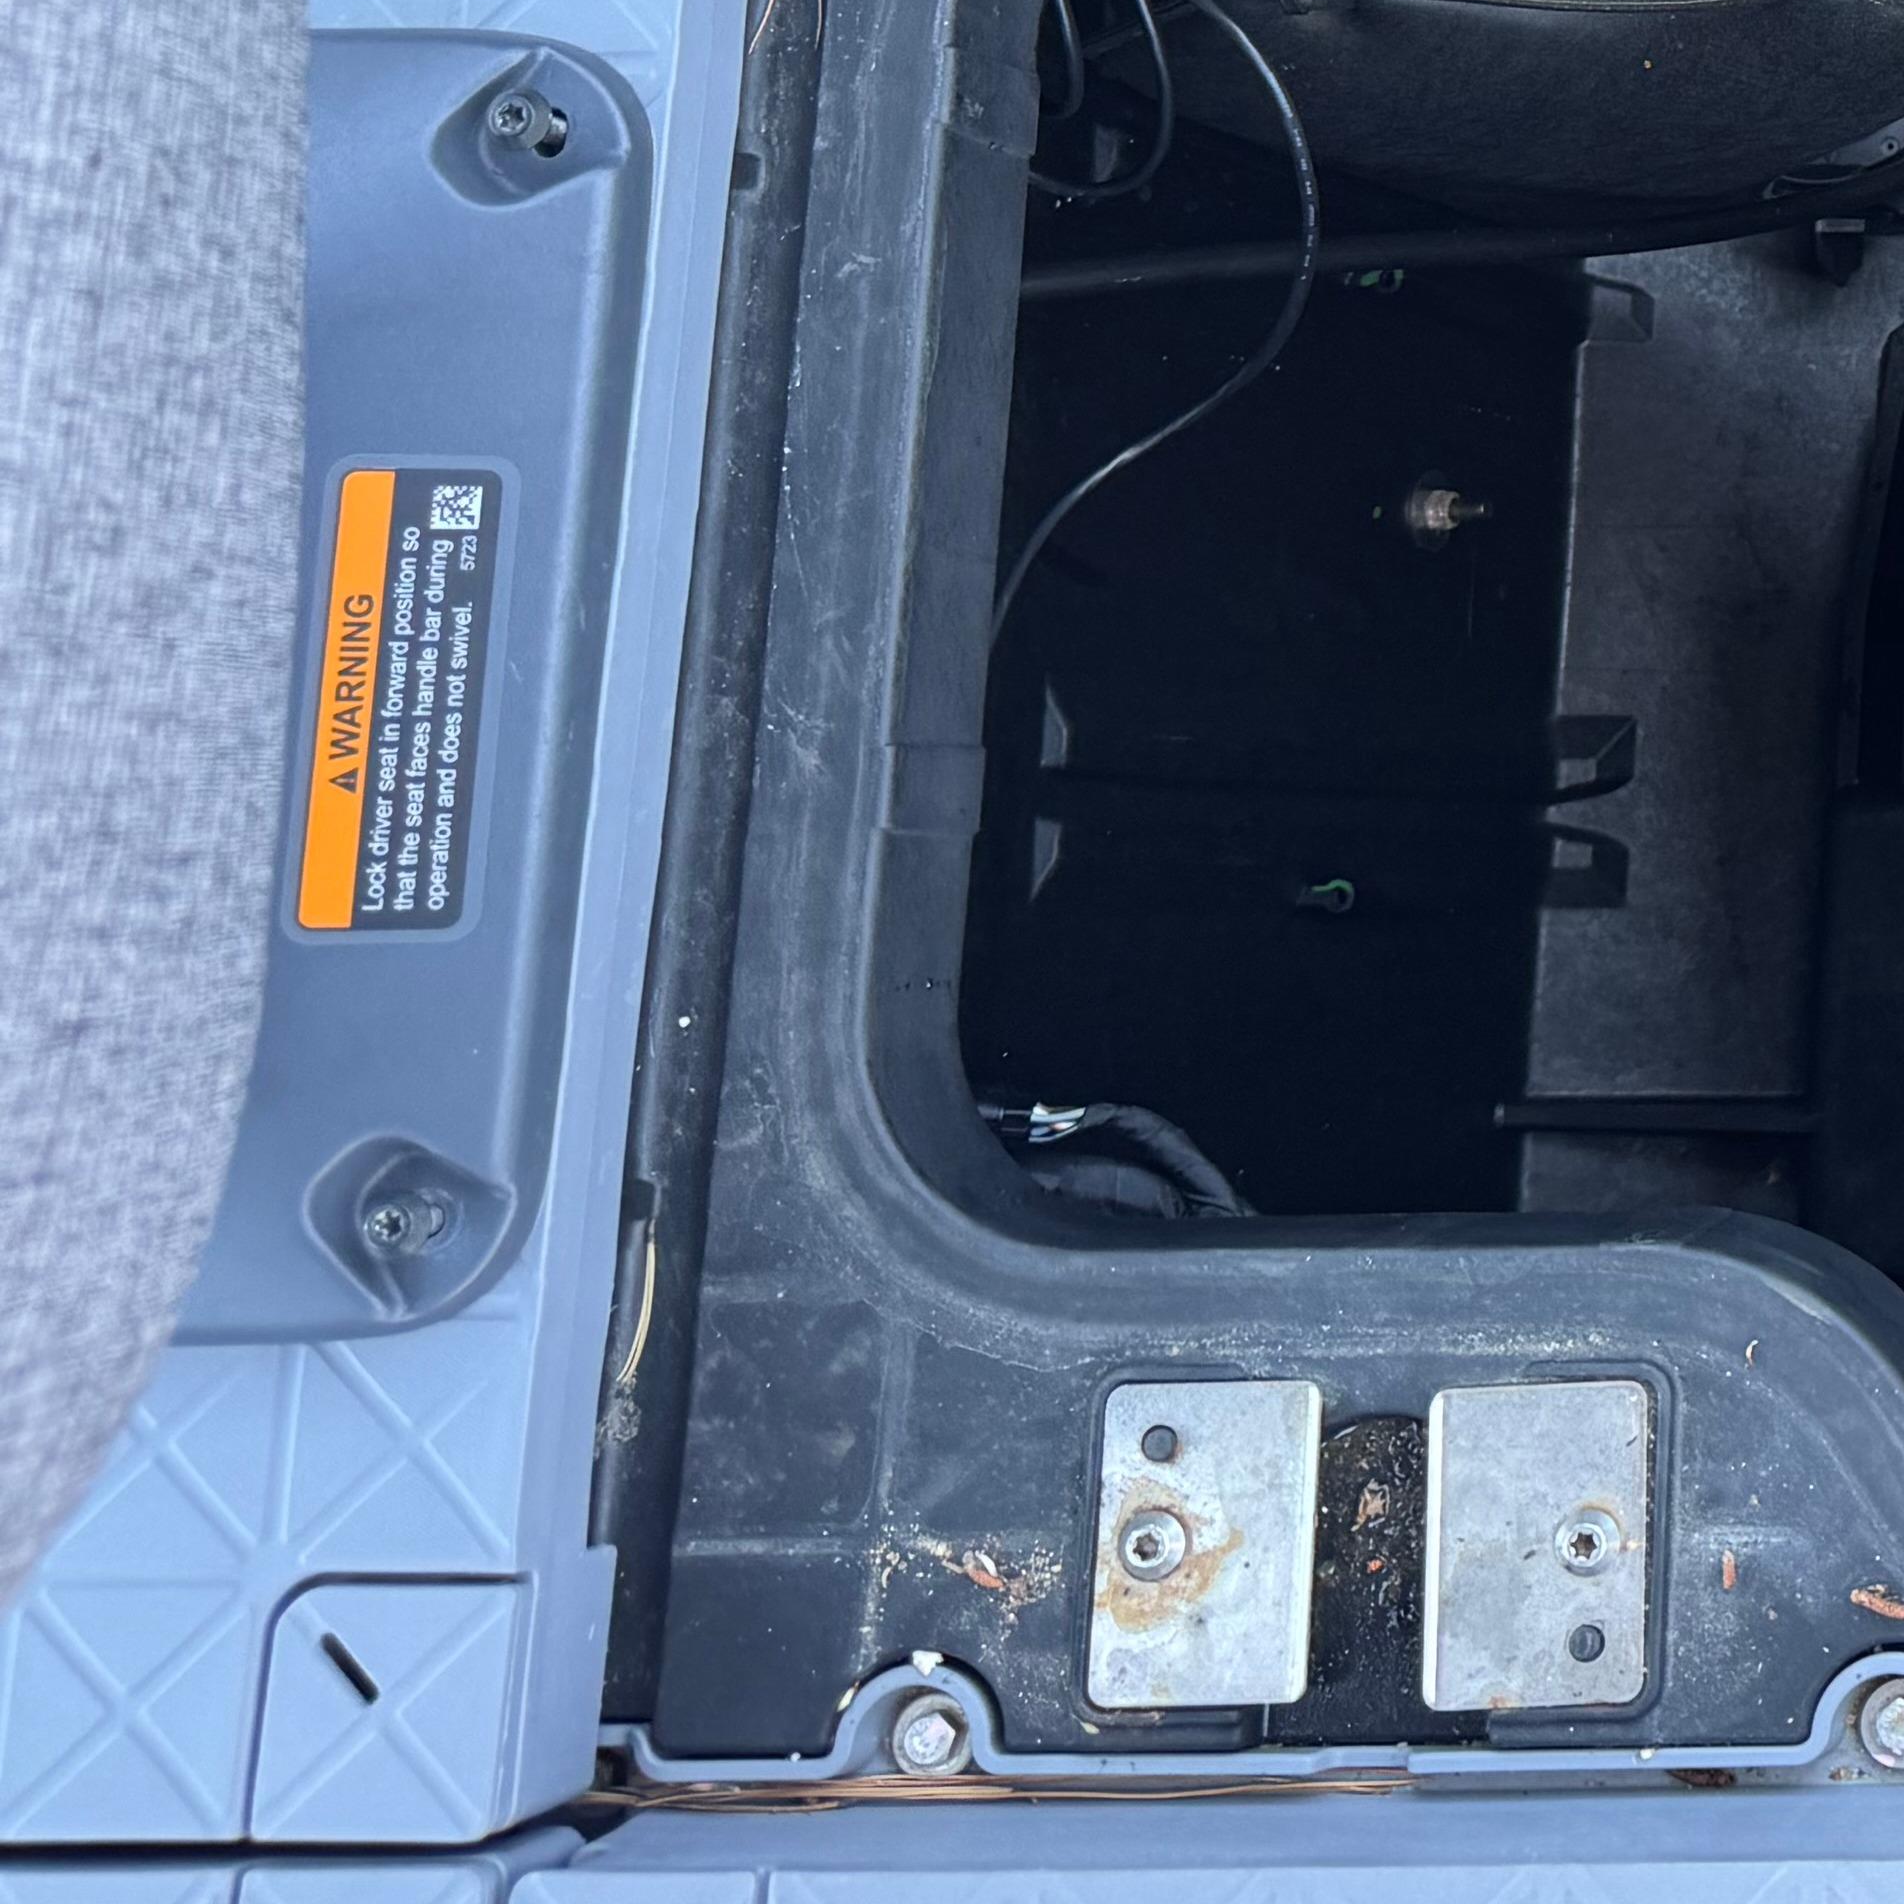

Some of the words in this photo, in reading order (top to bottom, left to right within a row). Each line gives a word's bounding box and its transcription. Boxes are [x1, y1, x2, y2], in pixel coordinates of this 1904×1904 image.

[402, 526, 421, 551] so
[460, 535, 478, 570] 5723
[388, 557, 421, 634] position
[422, 540, 454, 603] during
[418, 608, 443, 641] bar
[446, 601, 473, 669] swivel.
[328, 592, 374, 759] WARNING
[380, 640, 409, 716] forward
[411, 647, 439, 715] handle
[445, 674, 466, 706] not
[378, 723, 401, 741] in
[405, 721, 432, 777] faces
[437, 712, 463, 762] does
[375, 747, 399, 791] seat
[433, 769, 458, 806] and
[367, 796, 394, 856] driver
[403, 784, 426, 826] seat
[397, 831, 422, 864] the
[423, 813, 457, 909] operation
[362, 862, 388, 911] Lock
[393, 870, 418, 910] that
